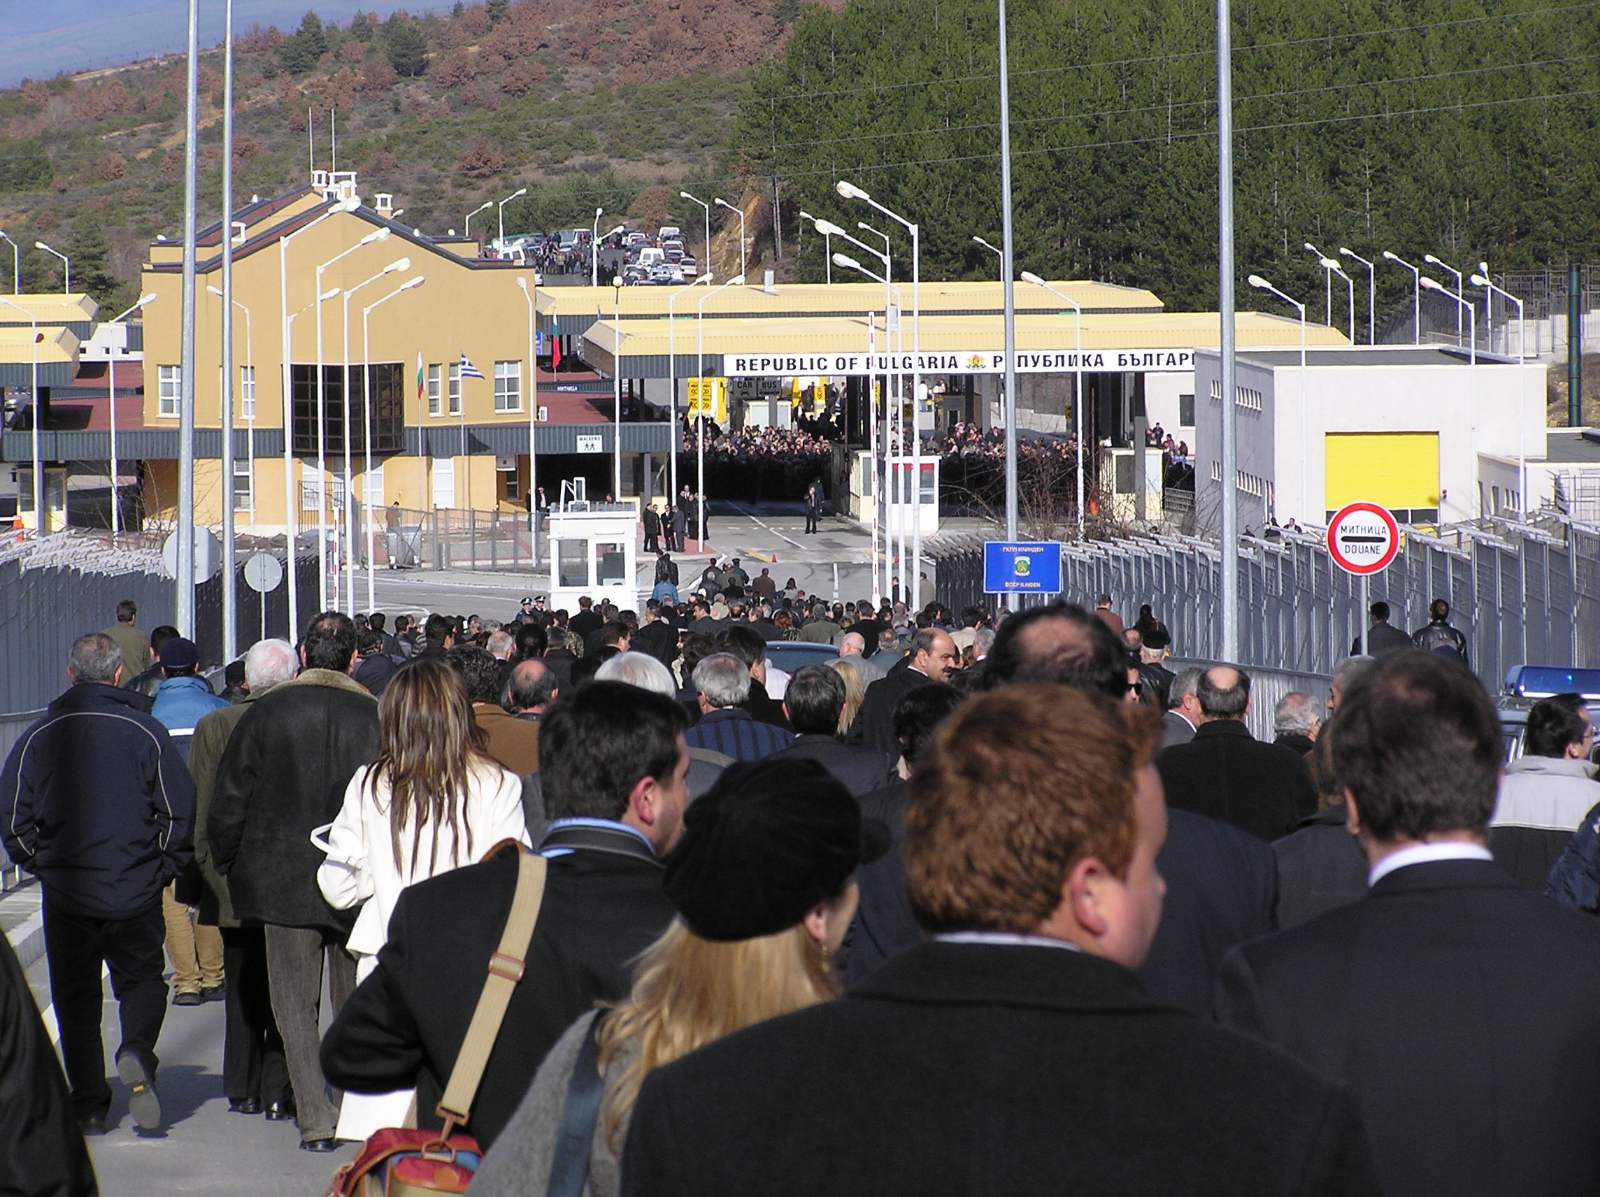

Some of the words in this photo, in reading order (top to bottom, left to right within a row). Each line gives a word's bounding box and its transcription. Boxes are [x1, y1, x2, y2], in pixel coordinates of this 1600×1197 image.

[736, 357, 828, 371] REPUBLIC
[835, 356, 859, 371] OF
[993, 353, 1105, 368] РПУБЛИКА
[1340, 525, 1387, 536] МИТНИЦА
[1344, 544, 1381, 555] DOUANE
